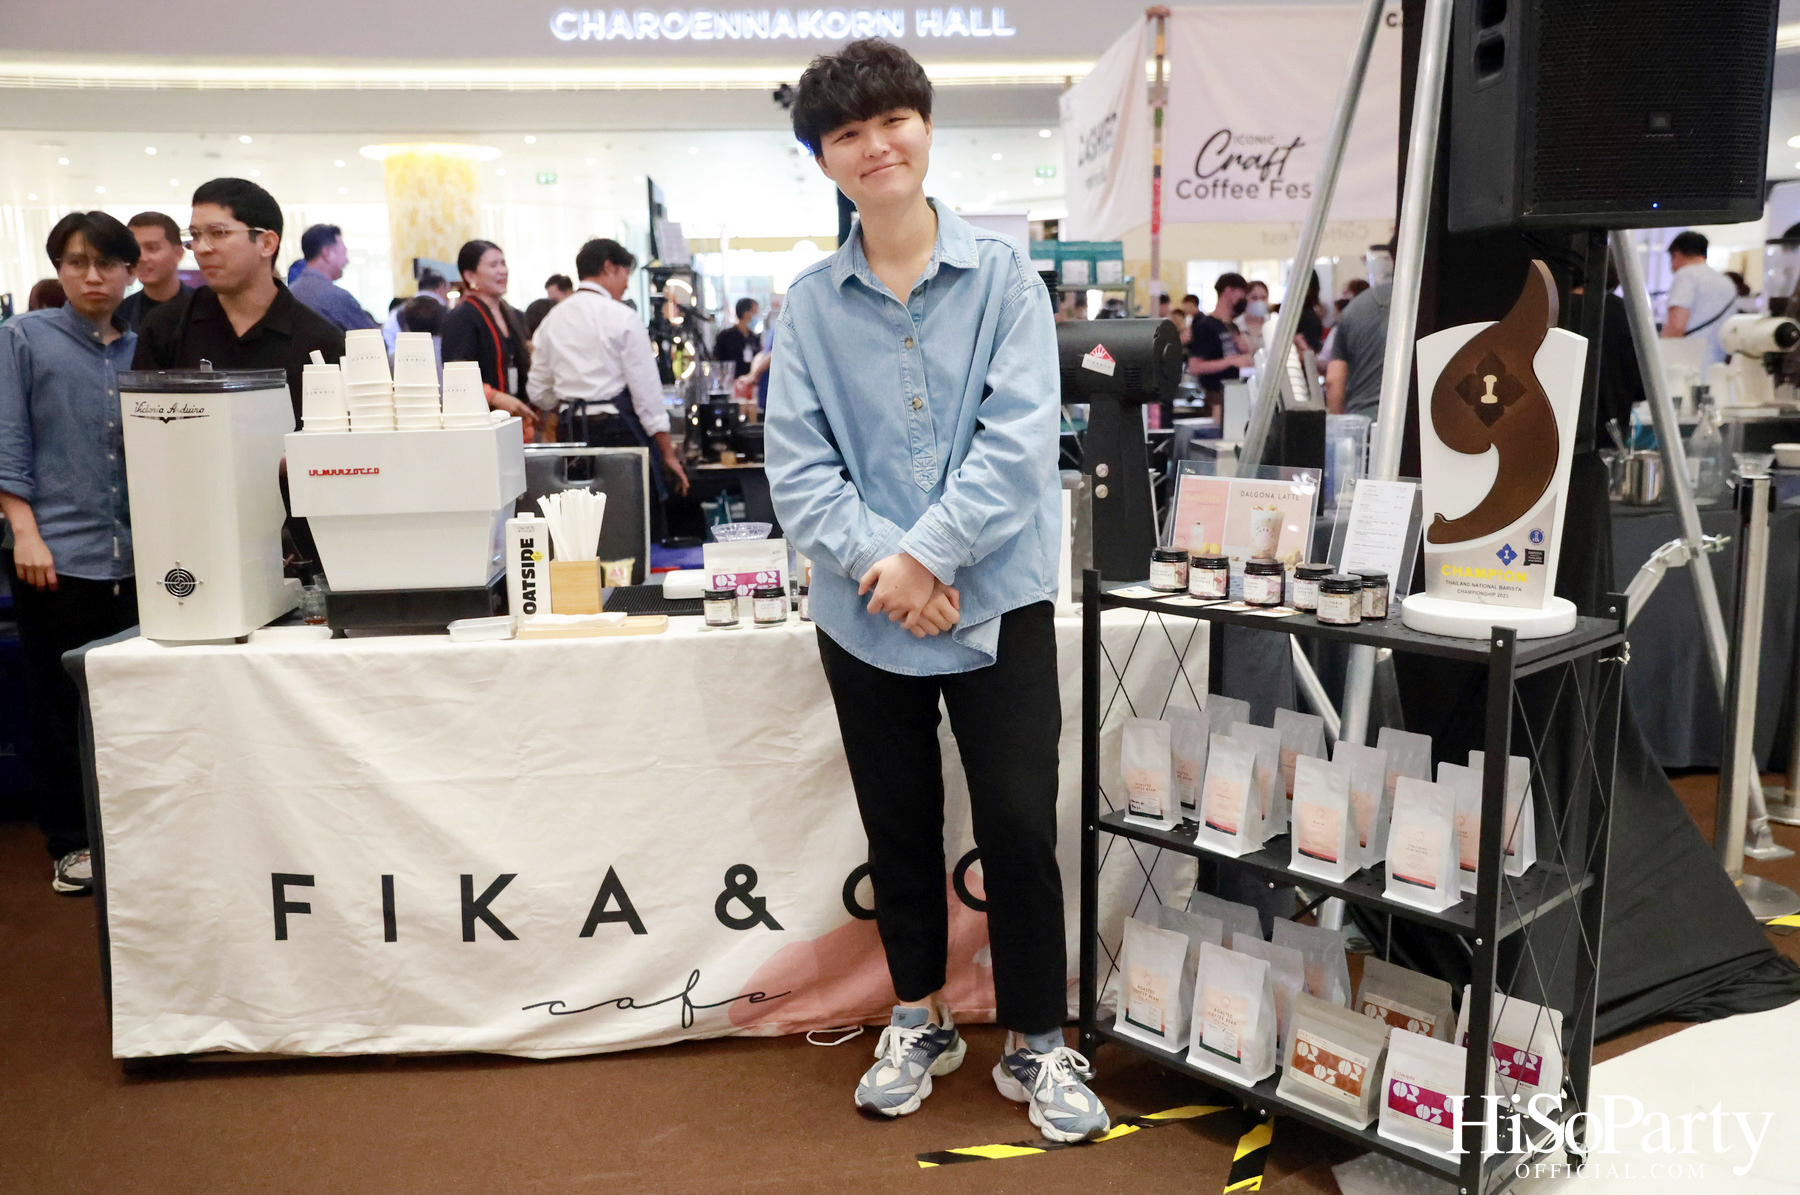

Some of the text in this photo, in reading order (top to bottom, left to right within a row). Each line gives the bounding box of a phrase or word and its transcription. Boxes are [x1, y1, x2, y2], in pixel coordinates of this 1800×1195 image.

[550, 7, 1017, 41] CHAROENNAKORN HALL
[1233, 134, 1275, 146] ICONIC
[1193, 128, 1306, 182] Craft
[1175, 179, 1312, 200] Coffee Fes
[134, 400, 206, 414] Victoria Arduino
[1239, 490, 1301, 502] DALGONA LATTE
[520, 537, 538, 615] OATSIDE
[1441, 564, 1528, 583] CHAMPION
[1445, 579, 1523, 593] THAILAND NATIONAL BARISTA
[1456, 588, 1497, 598] CHAMPIONSHIP
[521, 969, 792, 1029] cafe
